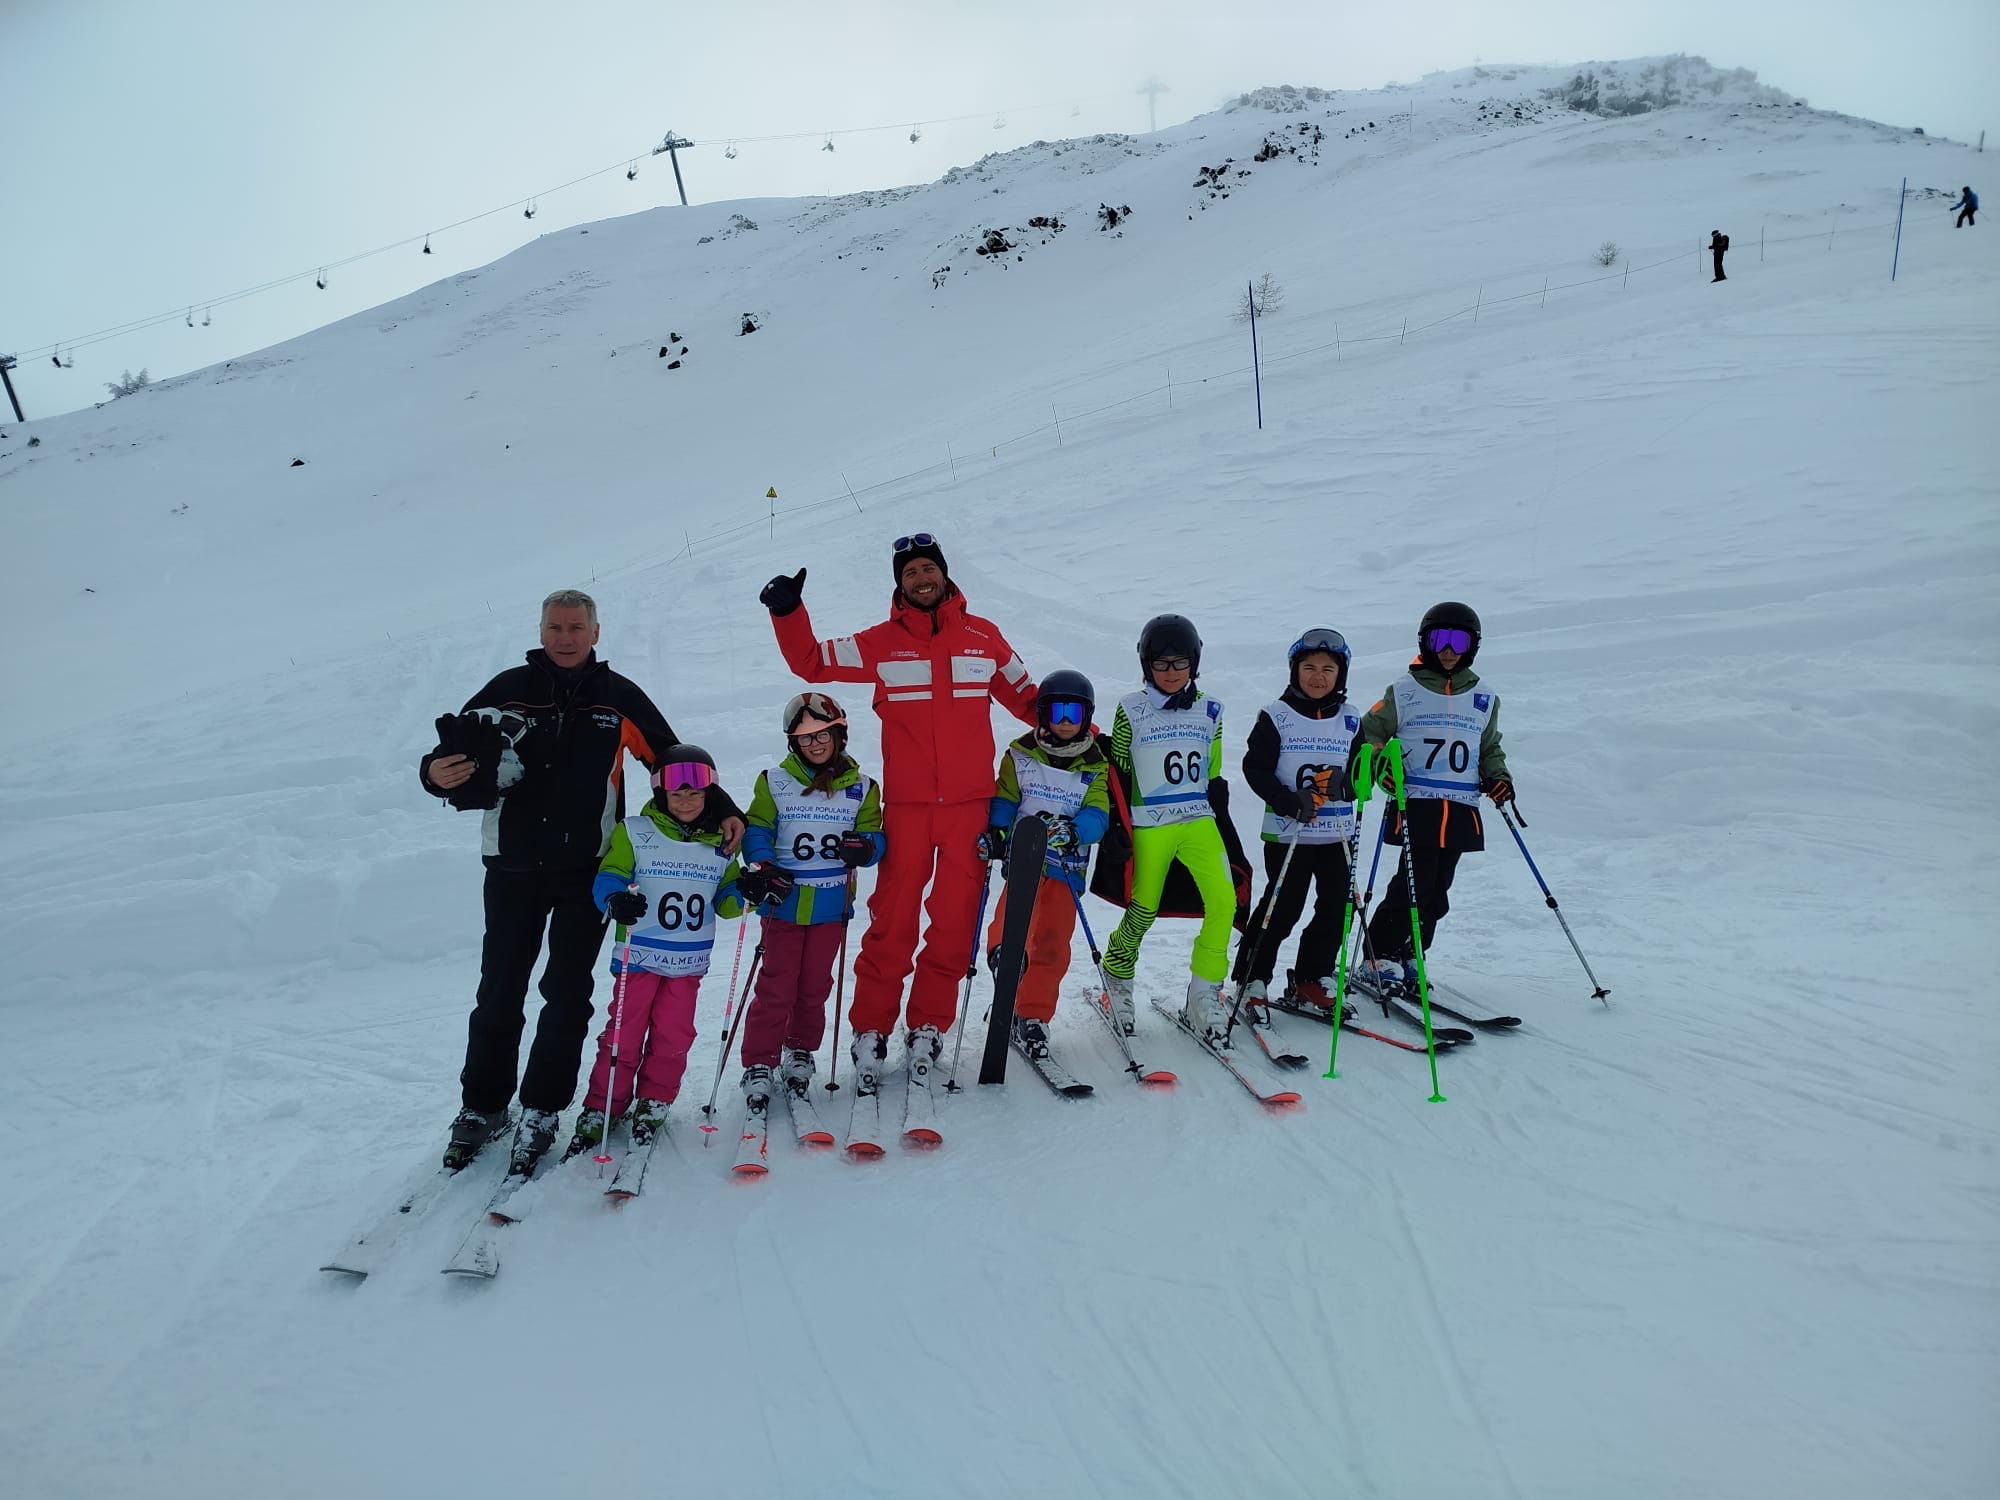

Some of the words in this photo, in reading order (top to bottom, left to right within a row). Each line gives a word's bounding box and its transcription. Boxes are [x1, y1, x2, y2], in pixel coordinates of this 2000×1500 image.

[1288, 736, 1316, 744] BANQUE
[1423, 737, 1470, 774] 70
[1163, 750, 1202, 785] 66
[785, 805, 814, 813] BANQUE
[815, 806, 851, 815] POPULAIRE
[813, 812, 841, 821] RHÔNE
[792, 832, 842, 861] 68
[638, 868, 681, 877] AUVERGNE
[682, 869, 707, 880] RHÔNE
[651, 860, 683, 869] BANQUE
[684, 862, 718, 874] POPULAIRE
[657, 891, 706, 931] 69
